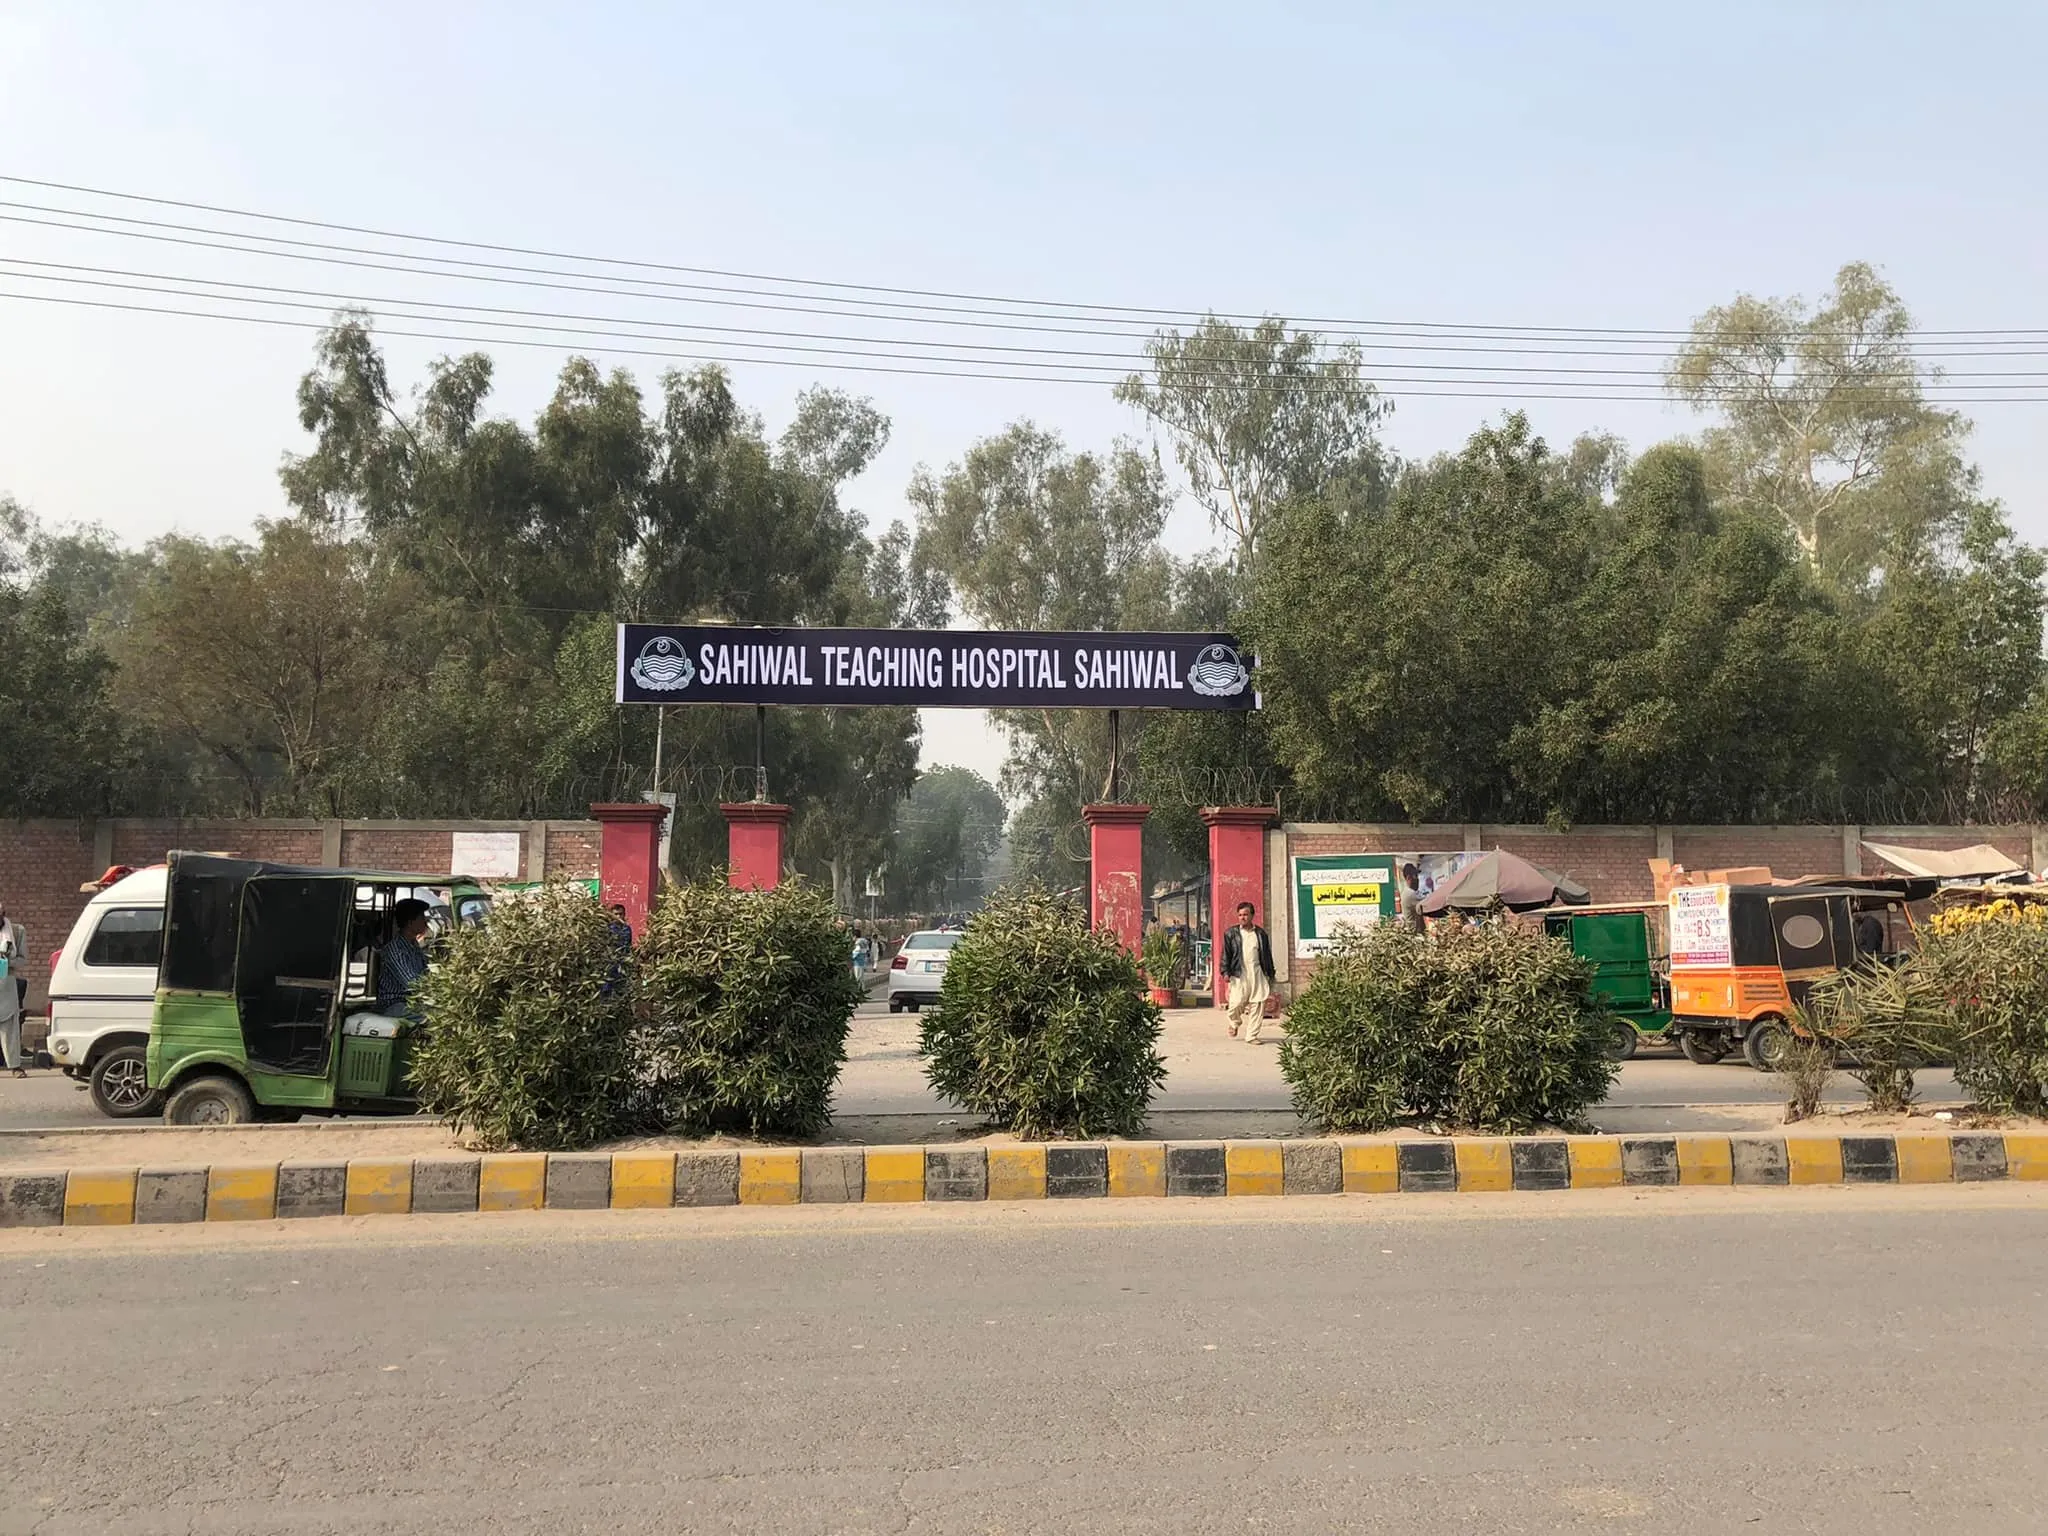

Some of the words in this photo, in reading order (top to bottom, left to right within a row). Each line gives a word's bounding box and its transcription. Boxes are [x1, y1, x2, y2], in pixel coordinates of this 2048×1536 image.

[699, 643, 813, 686] SAHIWAL
[821, 646, 944, 688] TEACHING
[951, 648, 1067, 689] HOSPITAL
[1074, 649, 1184, 689] SAHIWAL
[1678, 892, 1690, 907] THE
[1690, 895, 1717, 906] EDUCATORS
